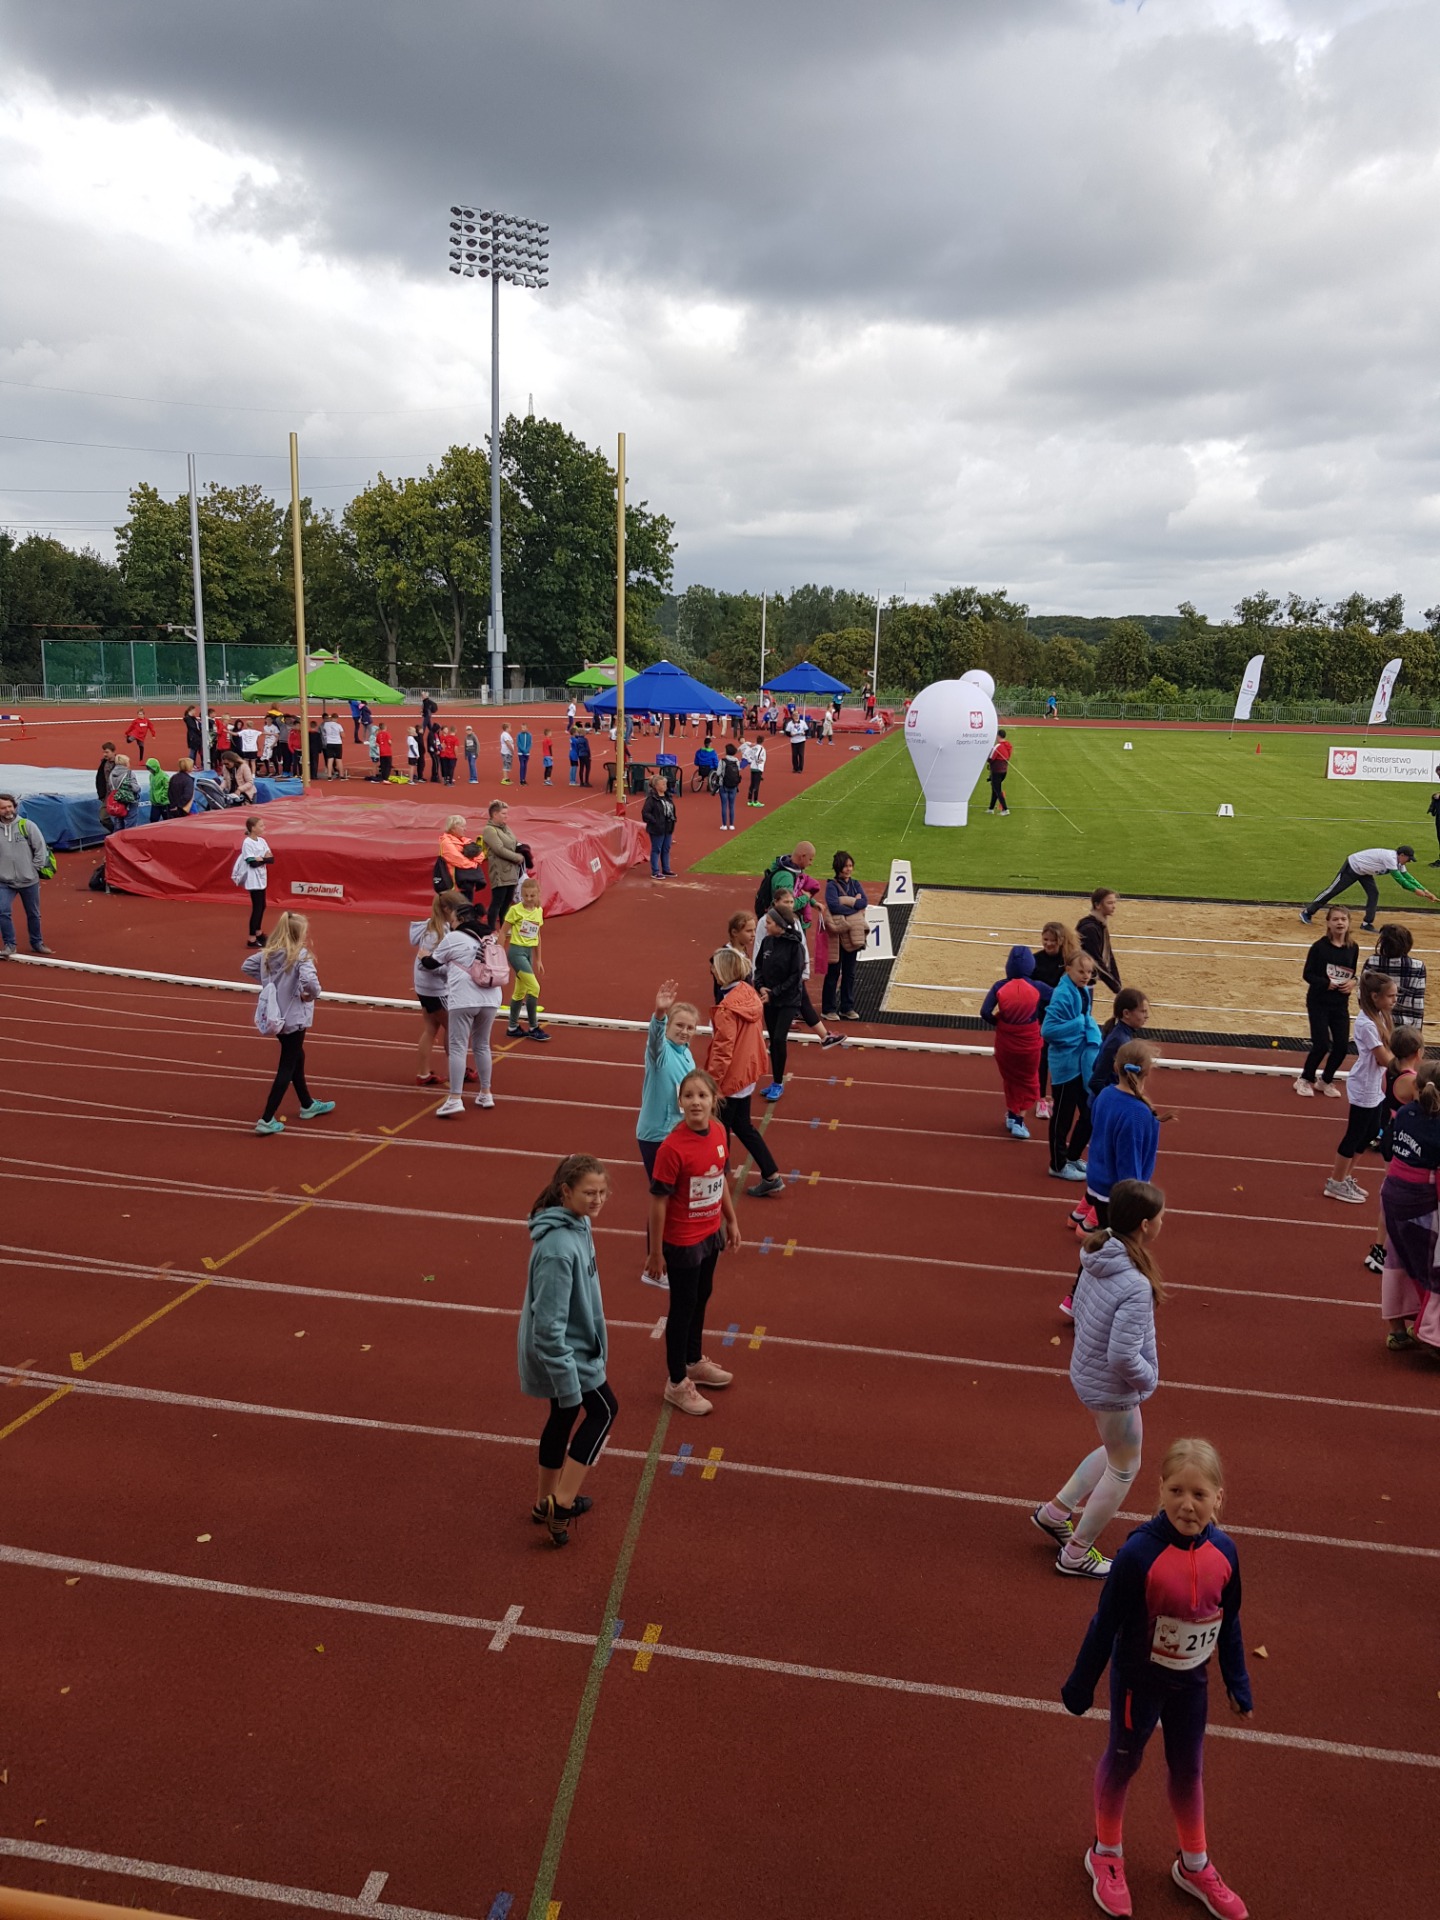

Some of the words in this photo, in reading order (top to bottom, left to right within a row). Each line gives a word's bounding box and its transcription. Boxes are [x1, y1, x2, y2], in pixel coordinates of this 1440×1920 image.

[1362, 755, 1412, 764] Ministerstwo
[1362, 765, 1388, 774] Sportu
[1394, 766, 1429, 776] Turystyki
[307, 885, 340, 894] polanik
[895, 875, 907, 894] 2
[871, 925, 880, 947] 1
[1335, 970, 1350, 979] 228
[707, 1179, 723, 1194] 184
[1185, 1626, 1217, 1652] 215
